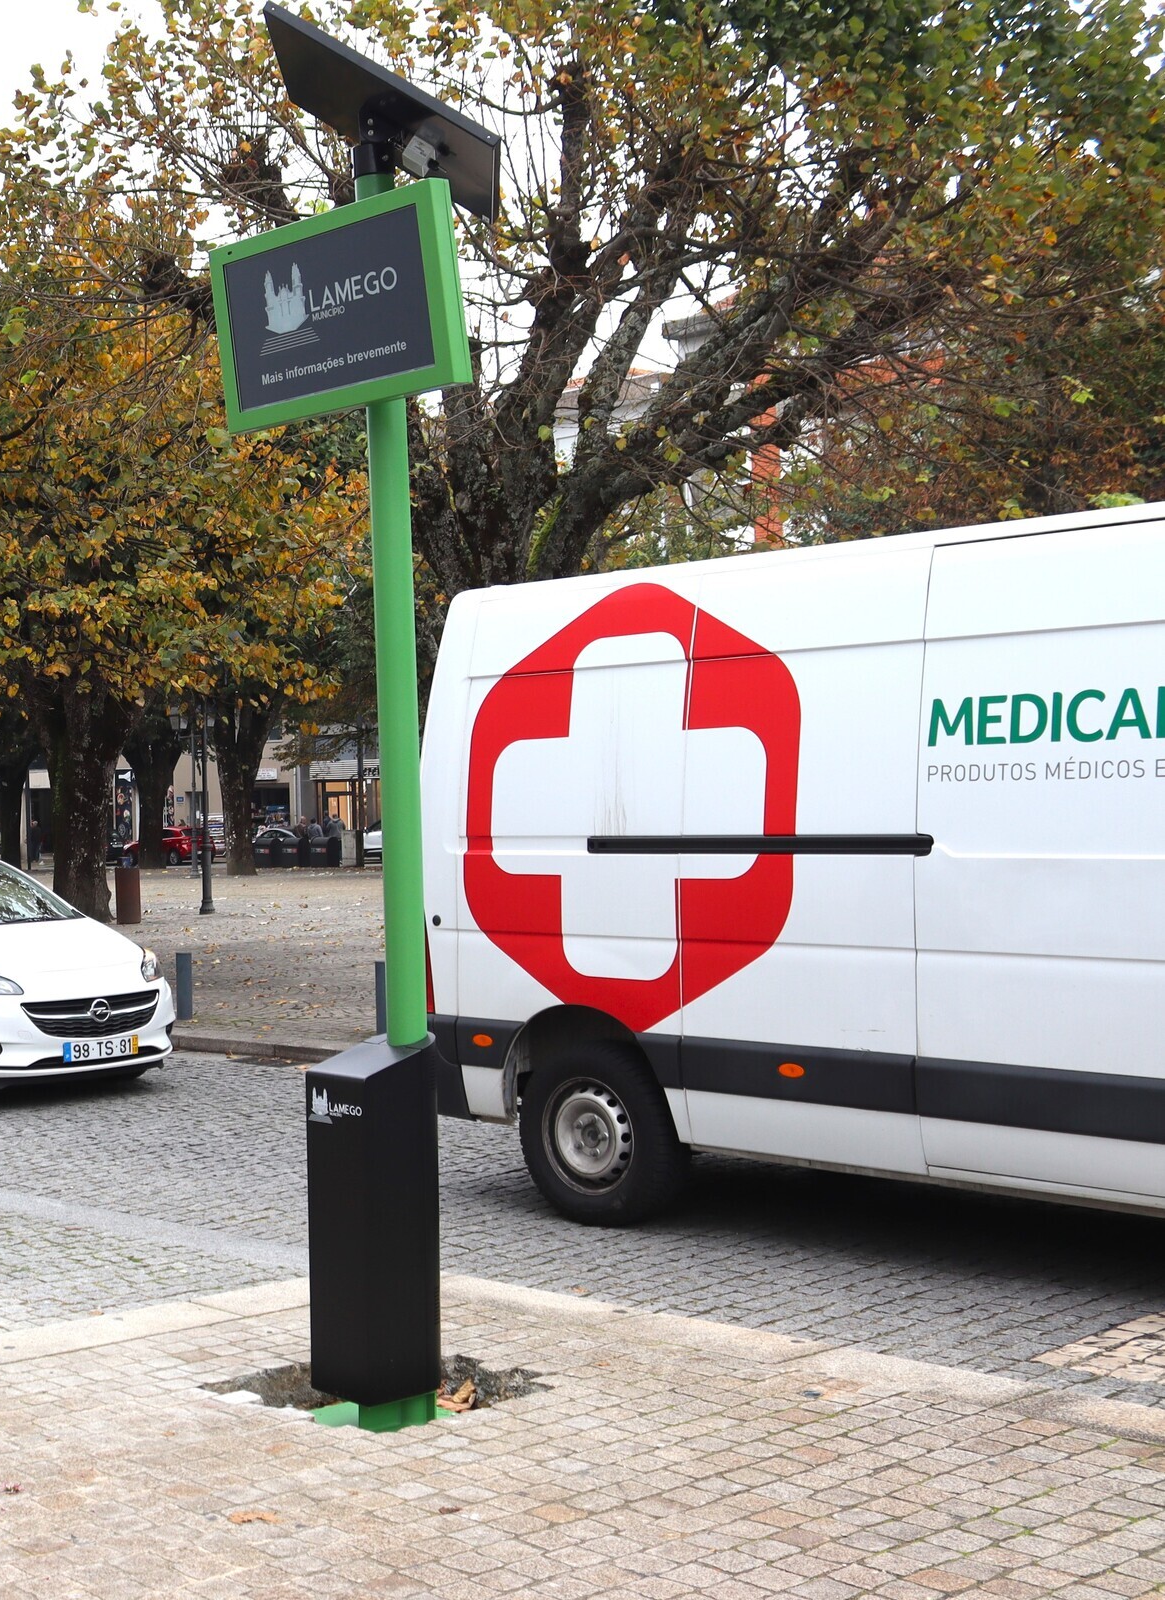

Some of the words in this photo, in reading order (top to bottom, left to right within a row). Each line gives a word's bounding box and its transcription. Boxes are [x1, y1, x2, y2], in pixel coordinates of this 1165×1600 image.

[309, 266, 397, 312] LAMEGO
[261, 371, 284, 386] Mais
[285, 357, 345, 380] informações
[347, 340, 407, 365] brevemente
[927, 763, 1037, 782] PRODUTOS
[1045, 756, 1145, 781] MÉDICOS
[329, 1101, 362, 1117] LAMEGO
